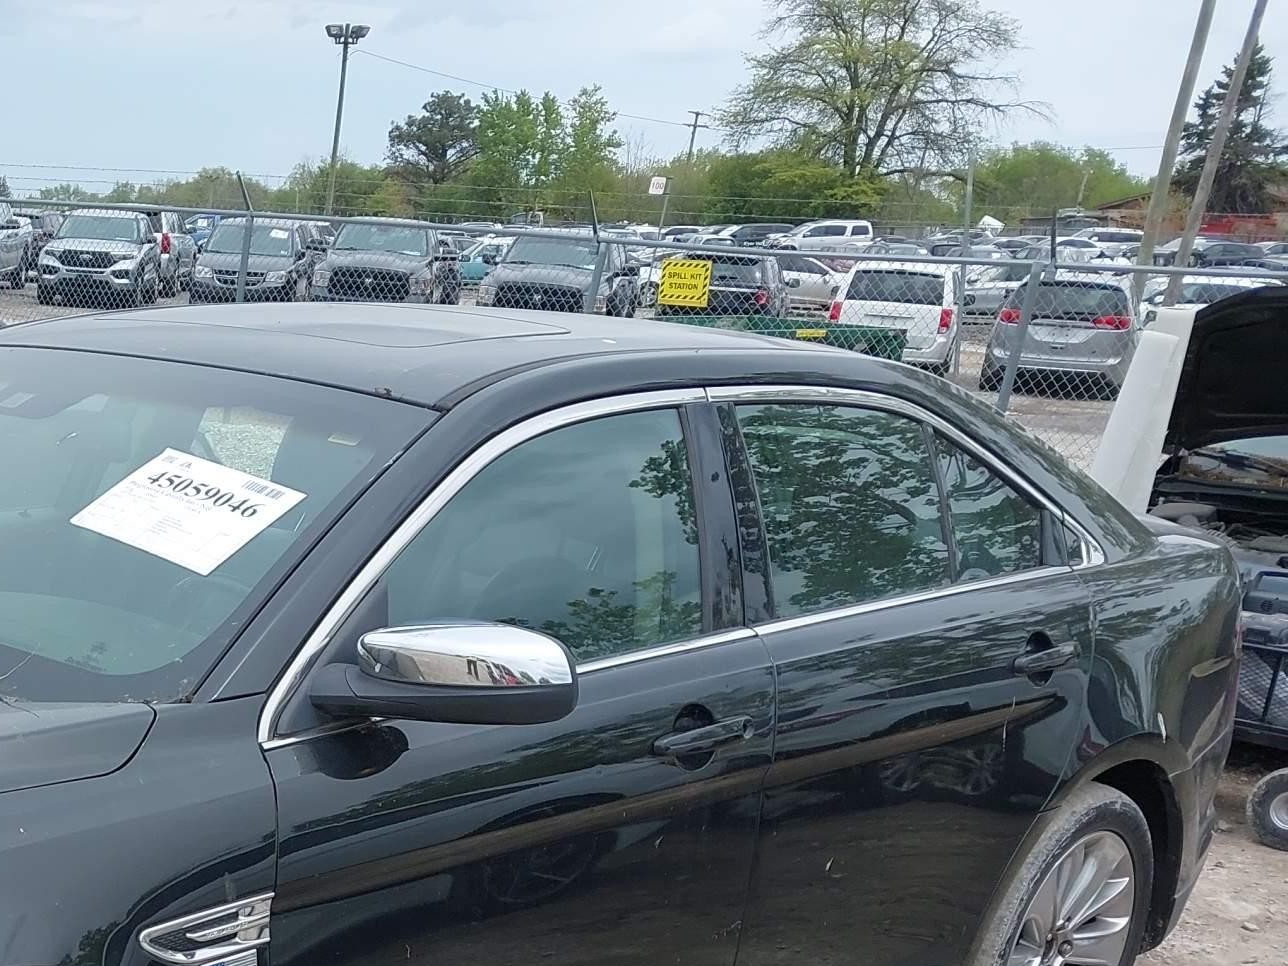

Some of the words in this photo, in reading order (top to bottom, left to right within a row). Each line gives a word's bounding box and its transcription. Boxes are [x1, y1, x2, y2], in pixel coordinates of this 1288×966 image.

[652, 182, 664, 190] 100
[667, 271, 688, 280] SPILL
[690, 272, 702, 281] KIT
[668, 282, 698, 291] STATION
[147, 471, 265, 518] 45059046
